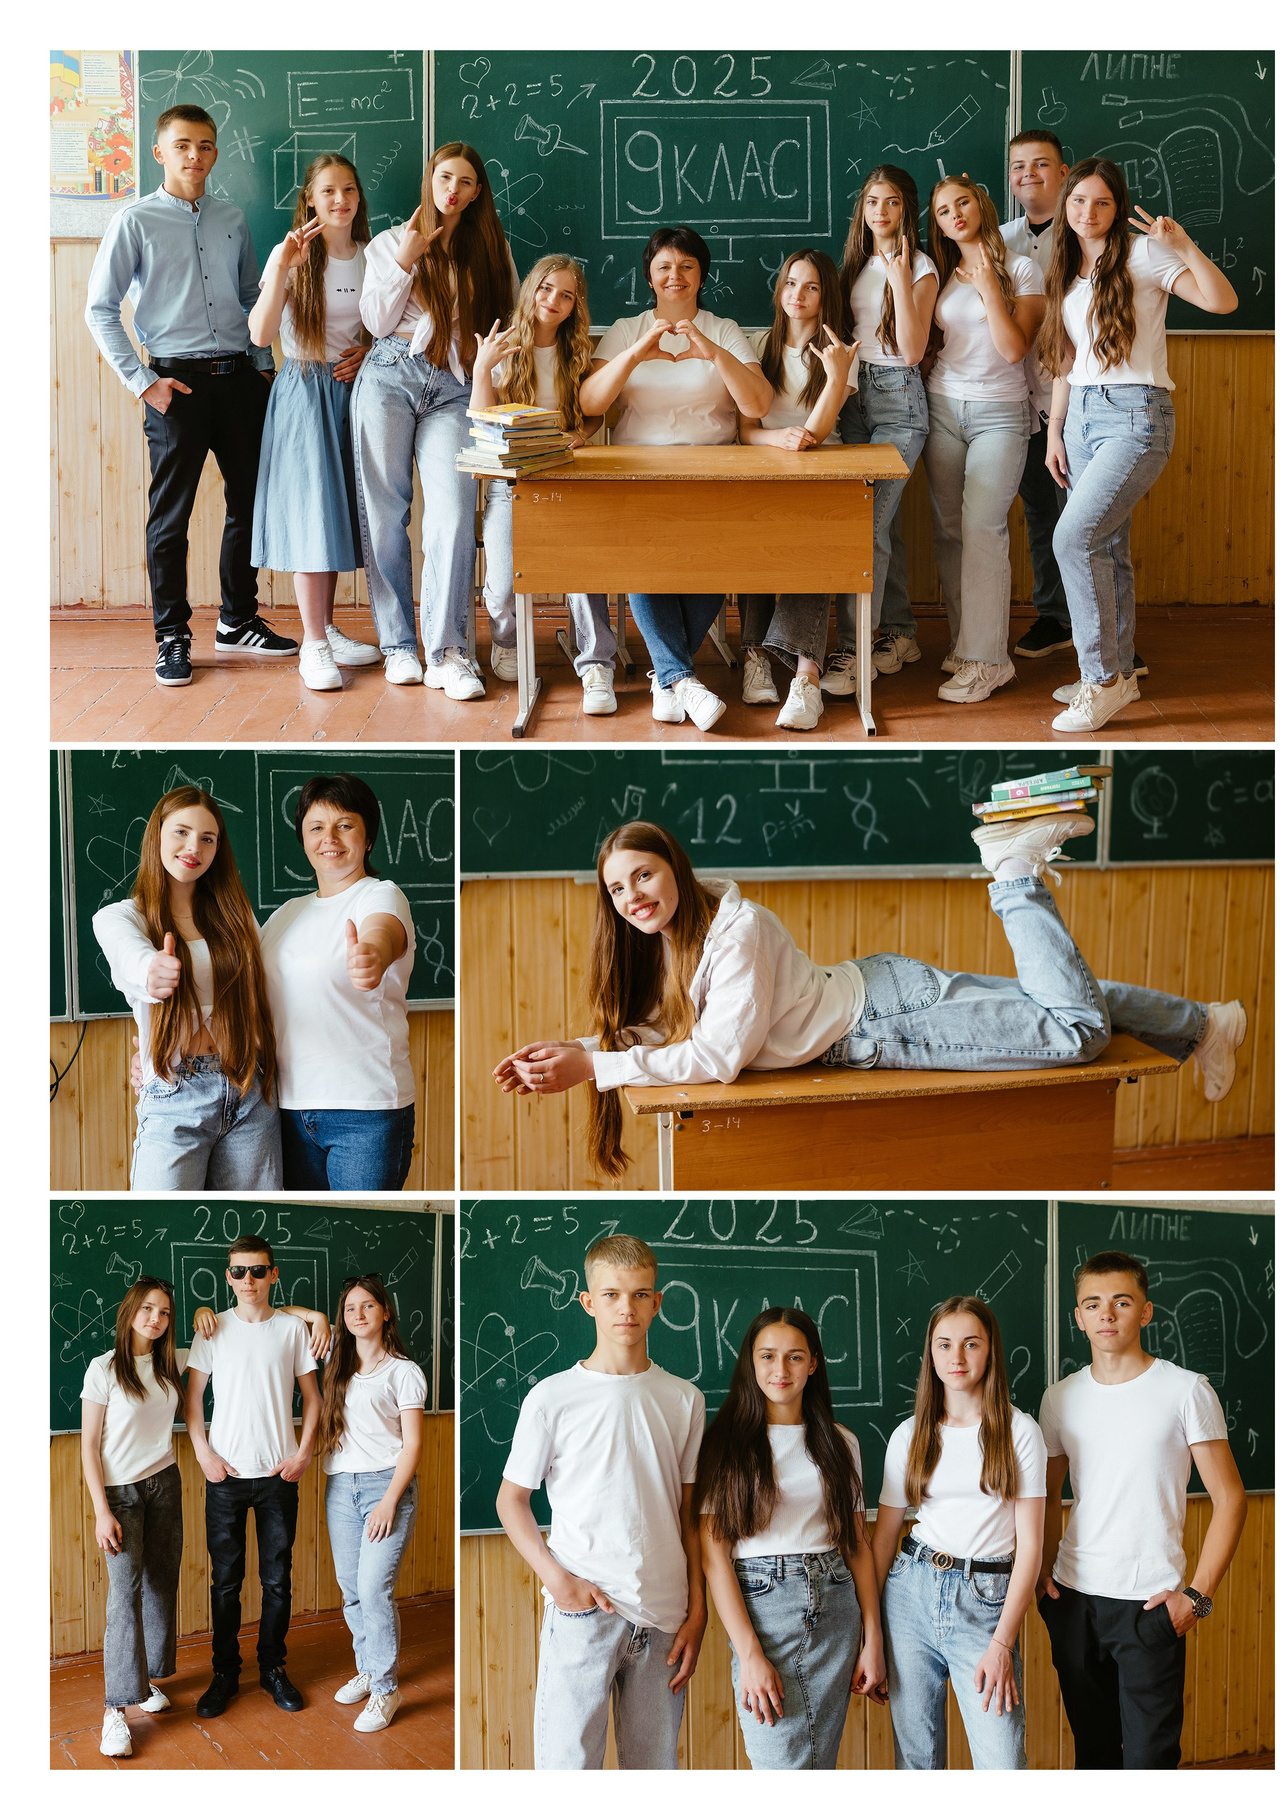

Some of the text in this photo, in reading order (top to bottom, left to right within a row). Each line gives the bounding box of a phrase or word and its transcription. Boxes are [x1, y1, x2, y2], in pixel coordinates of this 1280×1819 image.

[632, 53, 772, 97] 2025
[1080, 52, 1182, 81] ЛИПНЕ
[1116, 156, 1162, 199] ДЗ
[678, 794, 742, 844] 12
[193, 1205, 292, 1244] 2025
[1109, 1210, 1192, 1241] ЛИПНЕ
